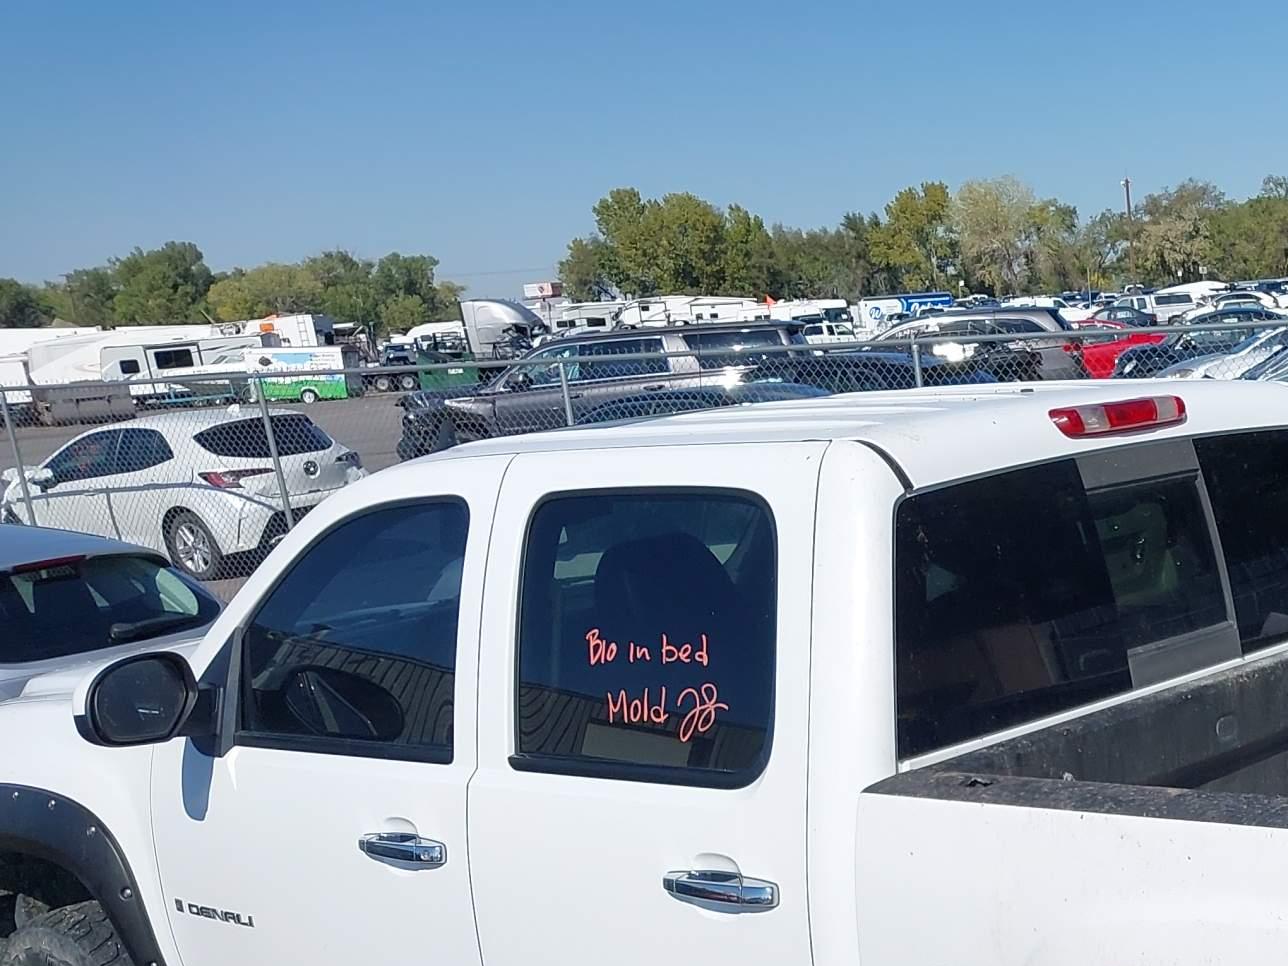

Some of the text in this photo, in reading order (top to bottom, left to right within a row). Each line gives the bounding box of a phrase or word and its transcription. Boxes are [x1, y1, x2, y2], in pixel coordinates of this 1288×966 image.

[661, 634, 708, 666] bed
[607, 685, 669, 724] Mold
[187, 902, 256, 928] DENALI
